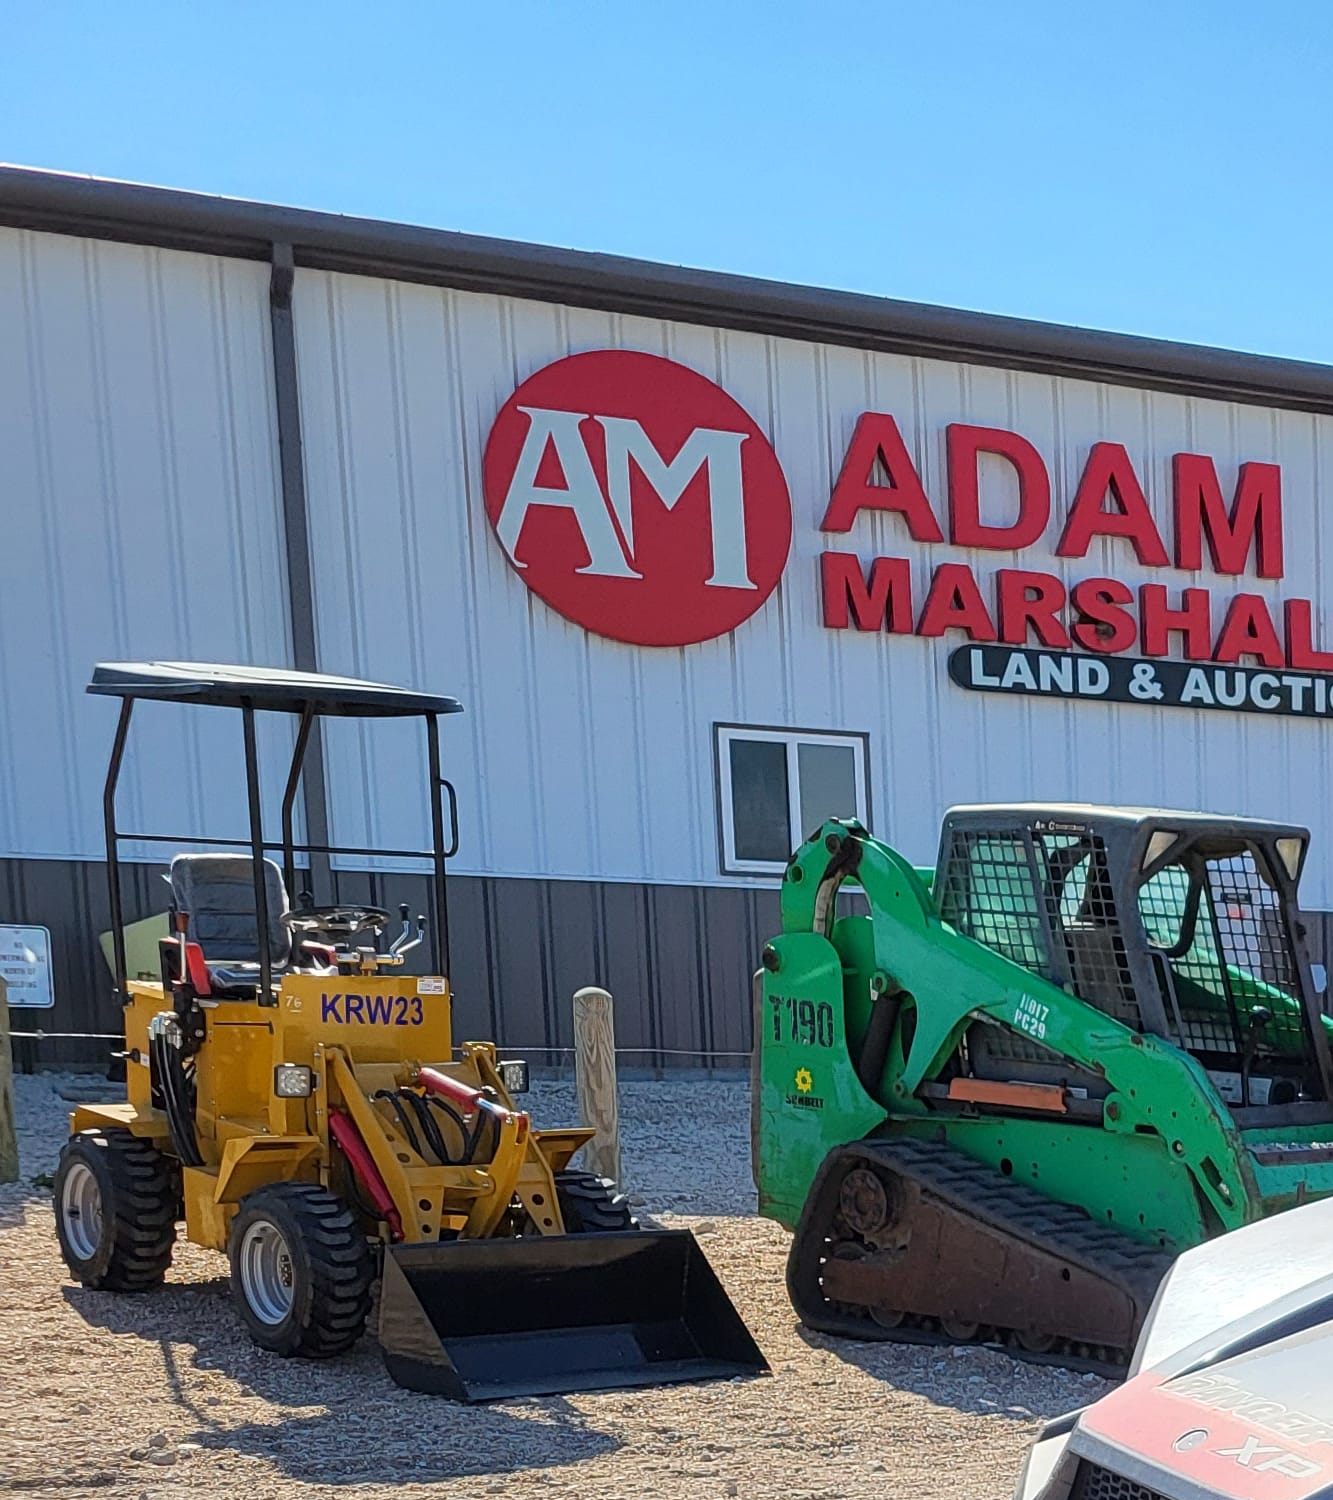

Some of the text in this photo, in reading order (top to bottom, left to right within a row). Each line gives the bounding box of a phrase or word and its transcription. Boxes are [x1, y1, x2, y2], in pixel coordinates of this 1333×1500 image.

[496, 405, 758, 590] AM
[819, 411, 1284, 579] ADAM
[968, 647, 1110, 696] LAND
[1128, 662, 1165, 700] &
[321, 993, 424, 1026] KRW23
[768, 994, 834, 1048] T190
[1014, 1008, 1046, 1039] PC29
[1215, 1434, 1322, 1479] XP
